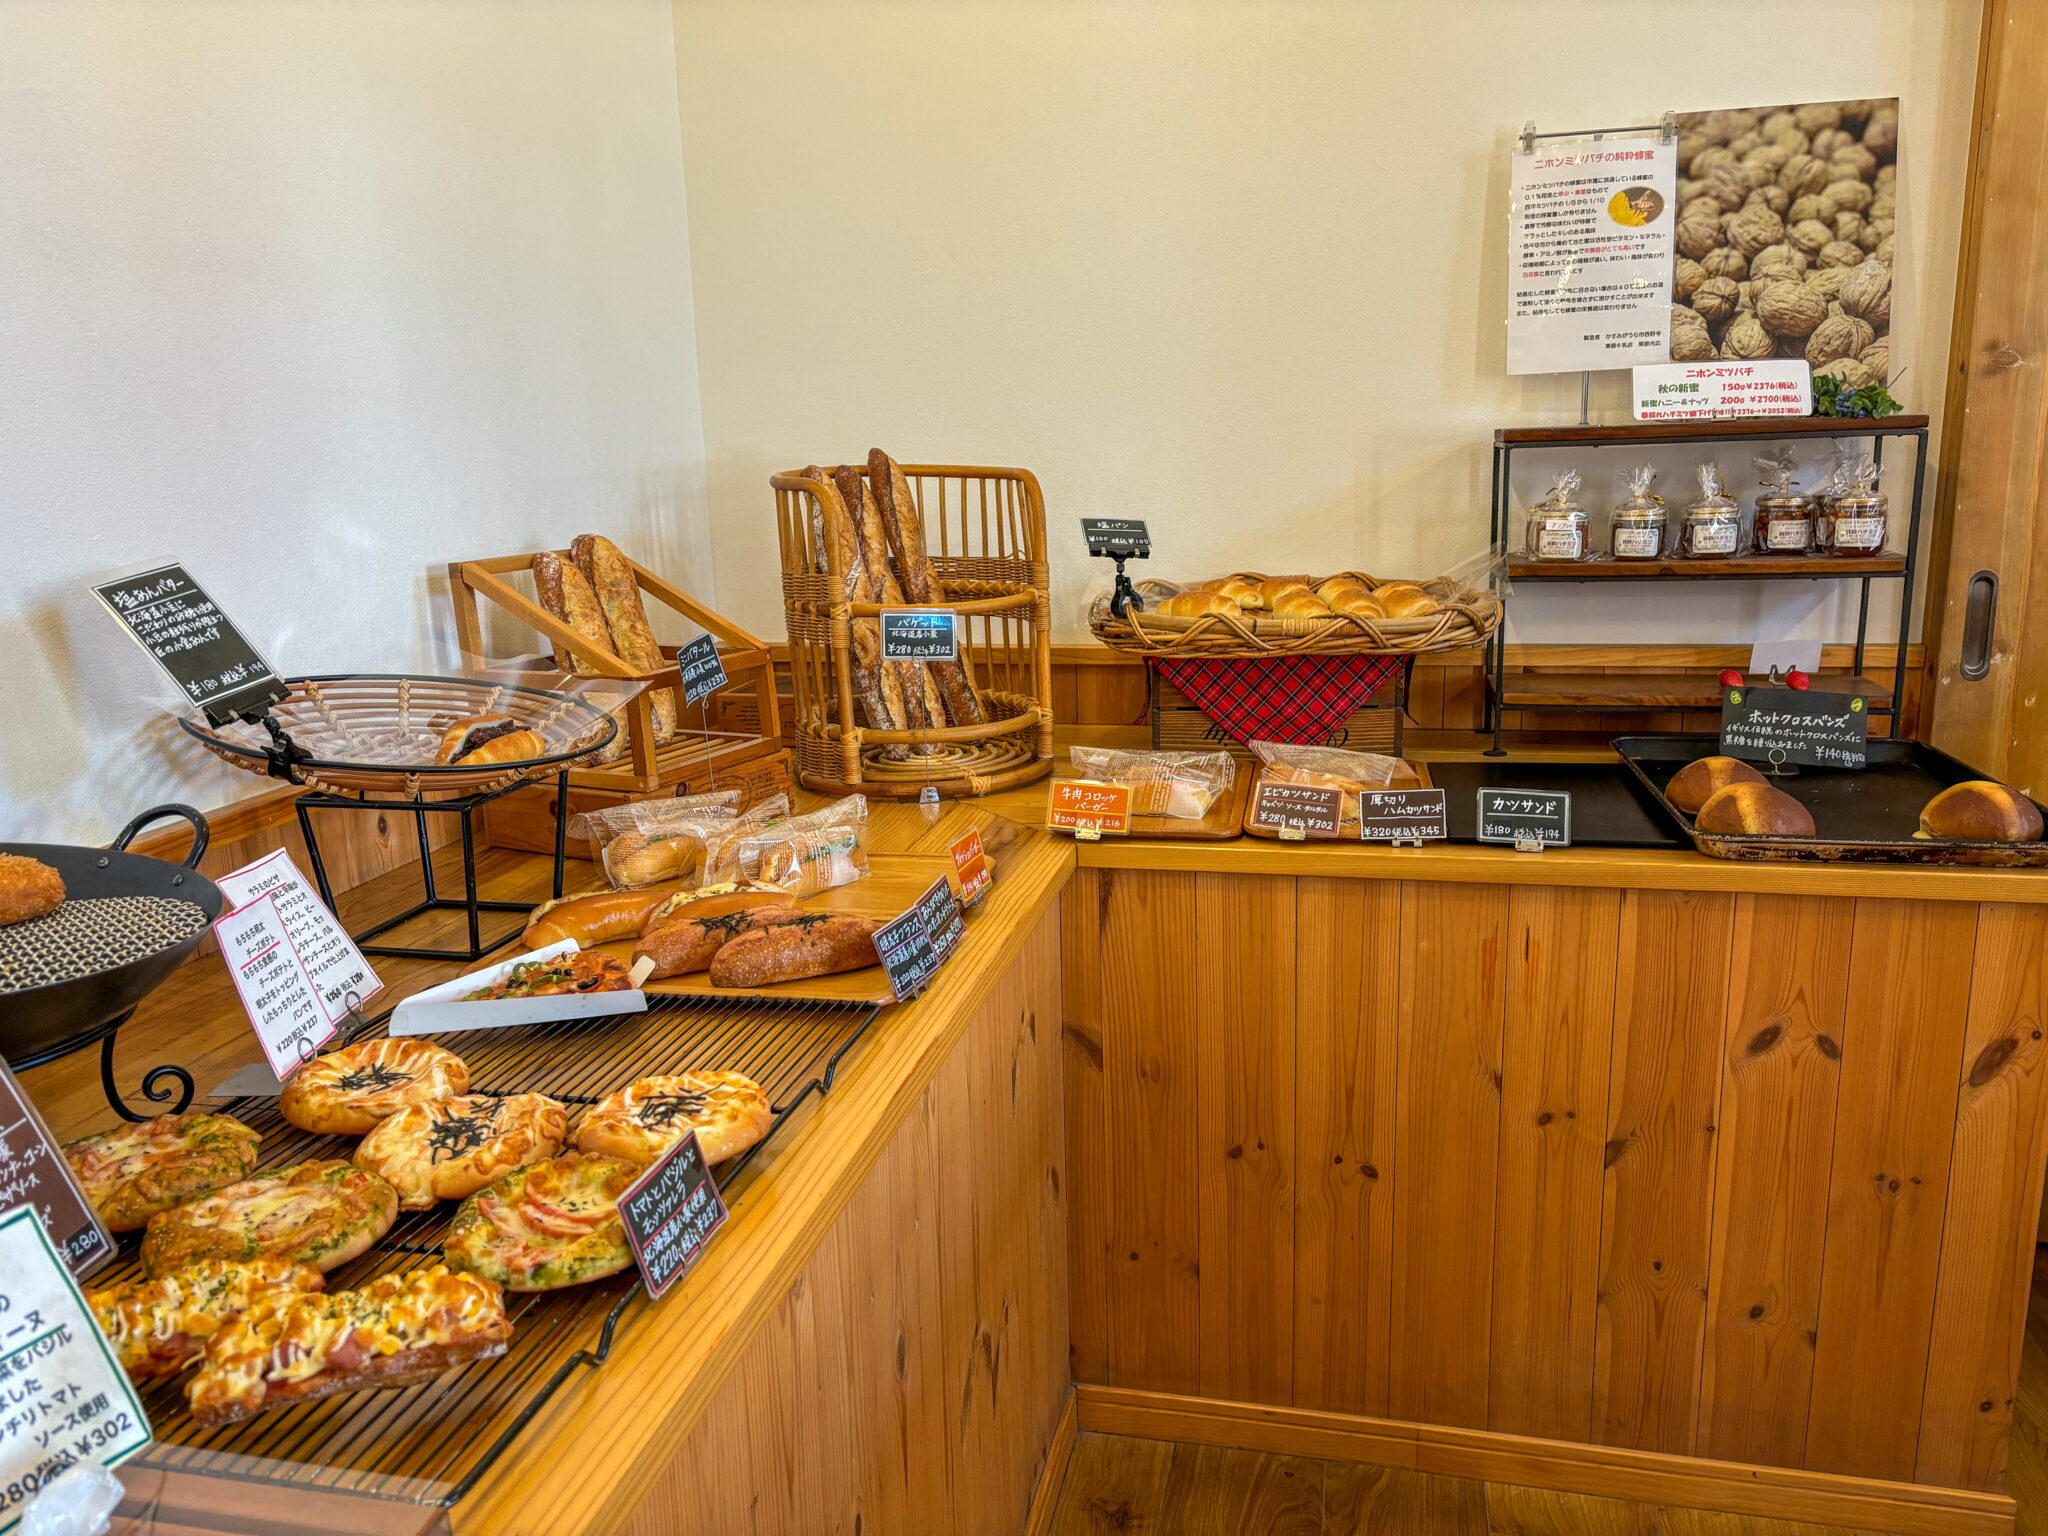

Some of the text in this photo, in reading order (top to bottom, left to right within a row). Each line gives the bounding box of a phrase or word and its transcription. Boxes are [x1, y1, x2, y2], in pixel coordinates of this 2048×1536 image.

[1686, 366, 1754, 378] ニホンミツバチ
[1658, 382, 1700, 394] 秋の新蜜
[1720, 396, 1745, 405] 200g
[1097, 521, 1128, 529] 塩パン
[112, 578, 185, 609] 塩あんバター
[127, 600, 186, 626] 北海道小豆に
[897, 617, 936, 628] バゲット
[186, 678, 218, 697] ¥180
[1749, 710, 1850, 728] ホットクロスバンズ
[1061, 786, 1117, 802] 牛肉コロッケ
[1263, 787, 1331, 802] エビカツサンド
[1370, 794, 1405, 806] 厚切り
[1074, 801, 1109, 811] バーガー
[1384, 803, 1443, 815] ハムカツサンド
[1492, 797, 1557, 815] カツサンド
[248, 873, 280, 896] サラミのピザ
[235, 920, 266, 947] もちもち明太
[879, 916, 922, 951] 明太子フランス
[246, 932, 276, 959] チーズポテト
[242, 950, 278, 980] もちもち食感の
[258, 959, 294, 989] チーズポテトと
[255, 970, 299, 1010] 明太子をトッピング
[262, 986, 308, 1025] したもっちりとした
[292, 999, 313, 1021] パンです
[630, 1149, 696, 1222] トマトとバジルと
[642, 1179, 686, 1236] モッツァレラ
[34, 1392, 109, 1449] ソース使用
